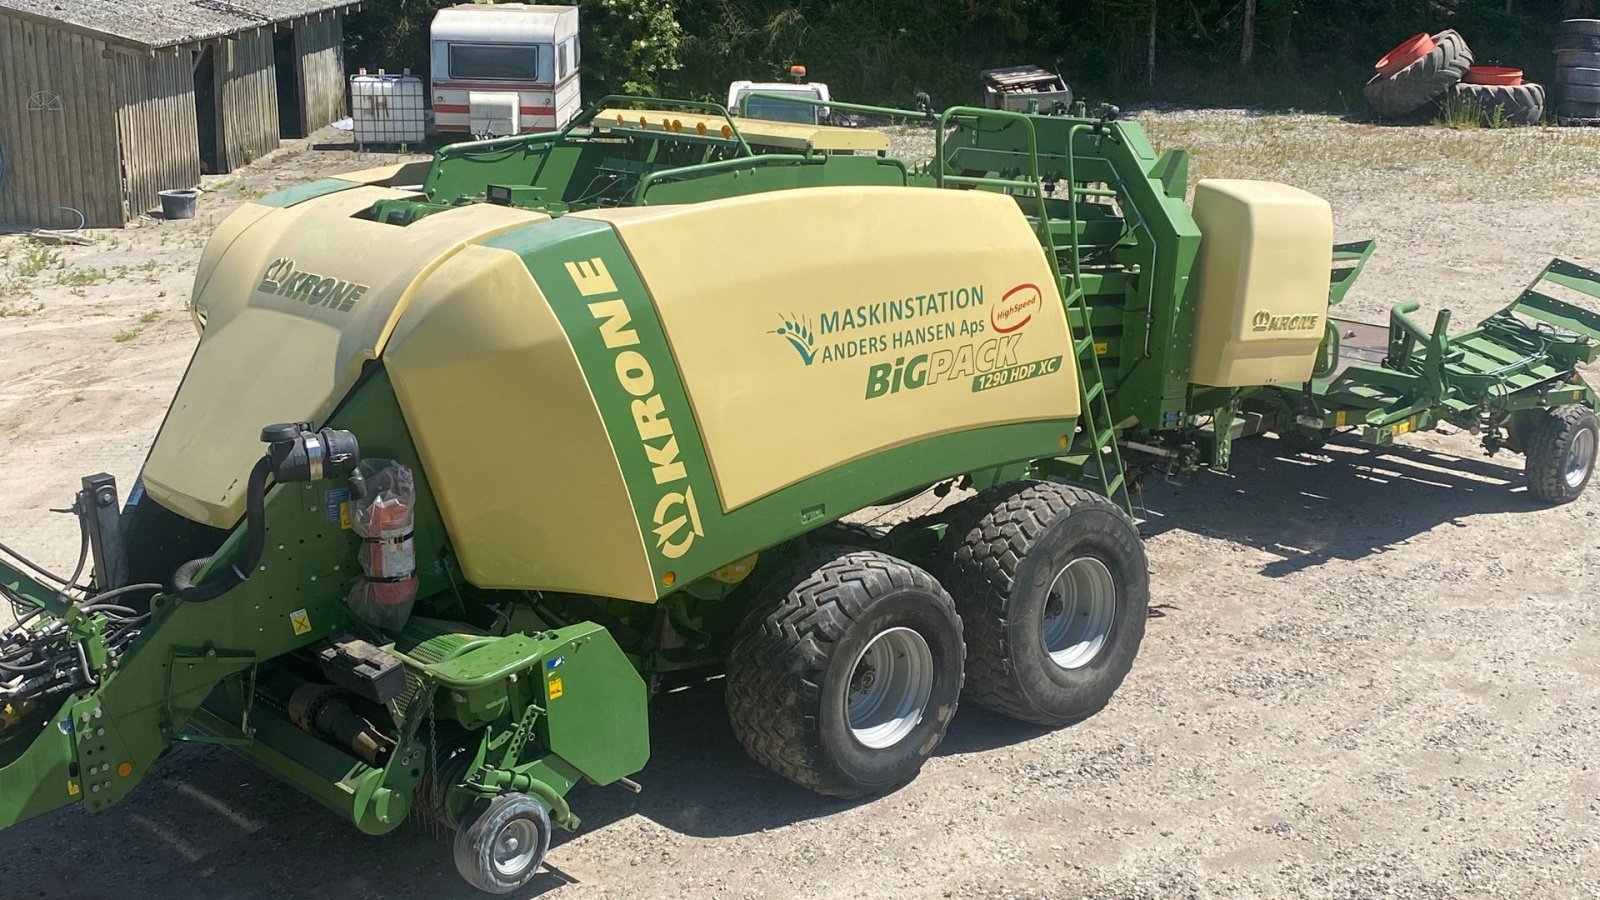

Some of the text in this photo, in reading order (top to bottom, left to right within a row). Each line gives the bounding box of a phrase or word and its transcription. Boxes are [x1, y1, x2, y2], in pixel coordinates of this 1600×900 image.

[276, 269, 370, 312] KRONE
[820, 285, 984, 335] MASKINSTATION
[996, 294, 1036, 321] HighSpeed
[822, 319, 985, 364] ANDERS HANSEN Aps
[1267, 315, 1319, 331] KRONE
[563, 256, 688, 485] KRONE
[979, 358, 1058, 390] 1290 HDP XC
